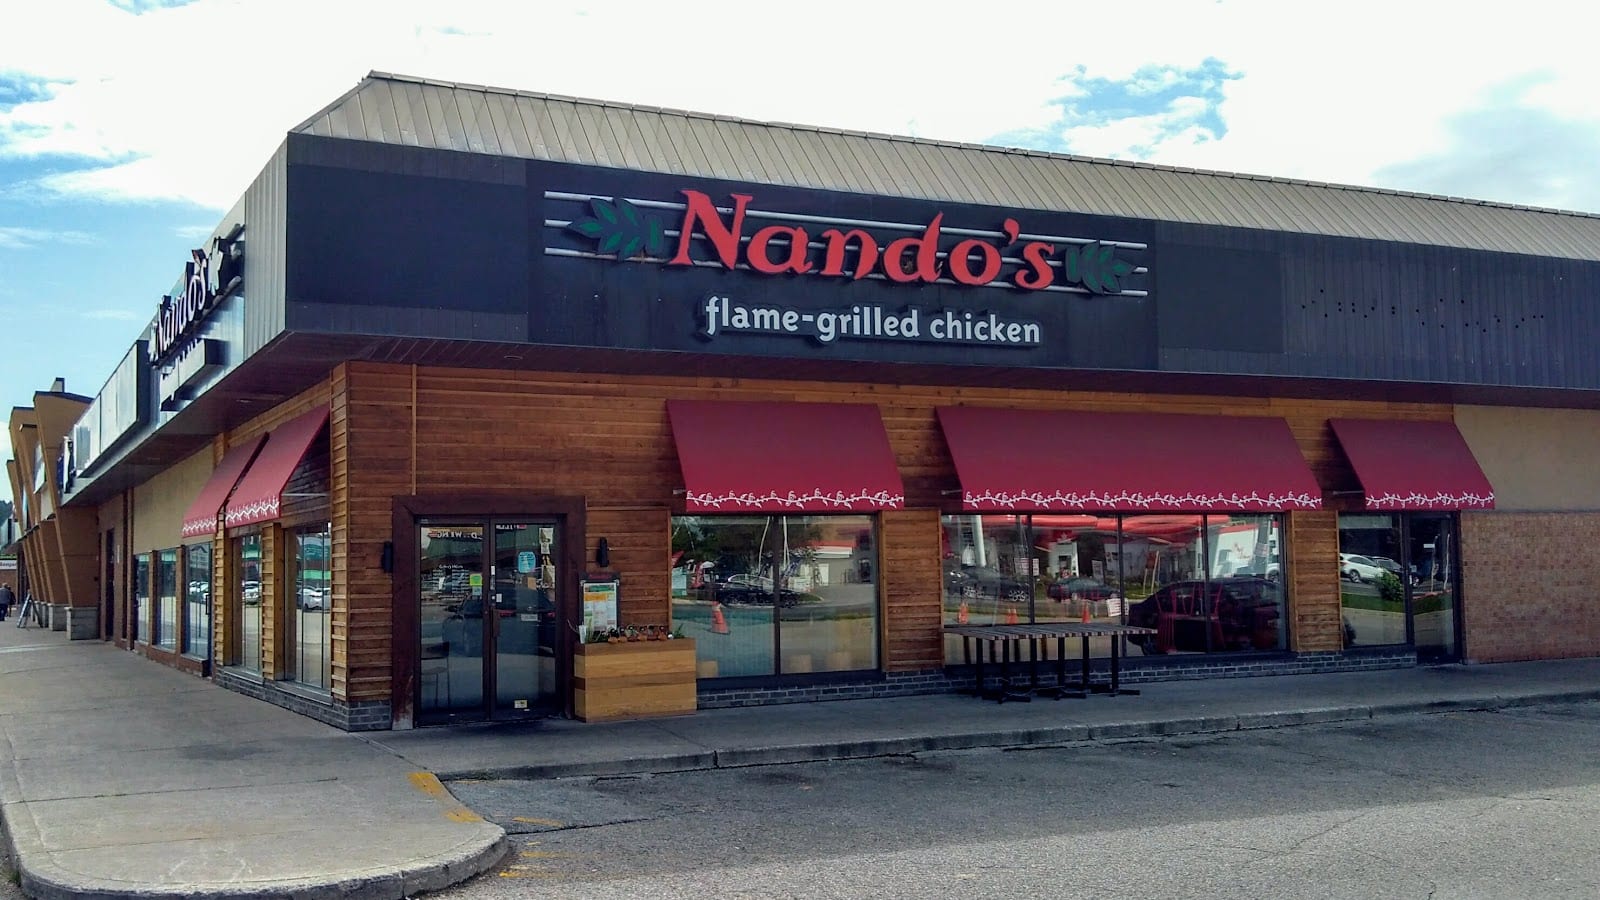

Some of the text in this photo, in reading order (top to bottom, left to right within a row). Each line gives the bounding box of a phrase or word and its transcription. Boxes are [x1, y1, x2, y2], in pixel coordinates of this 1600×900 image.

[668, 189, 1056, 291] Nando's
[705, 296, 1041, 346] flame-grilled chicken
